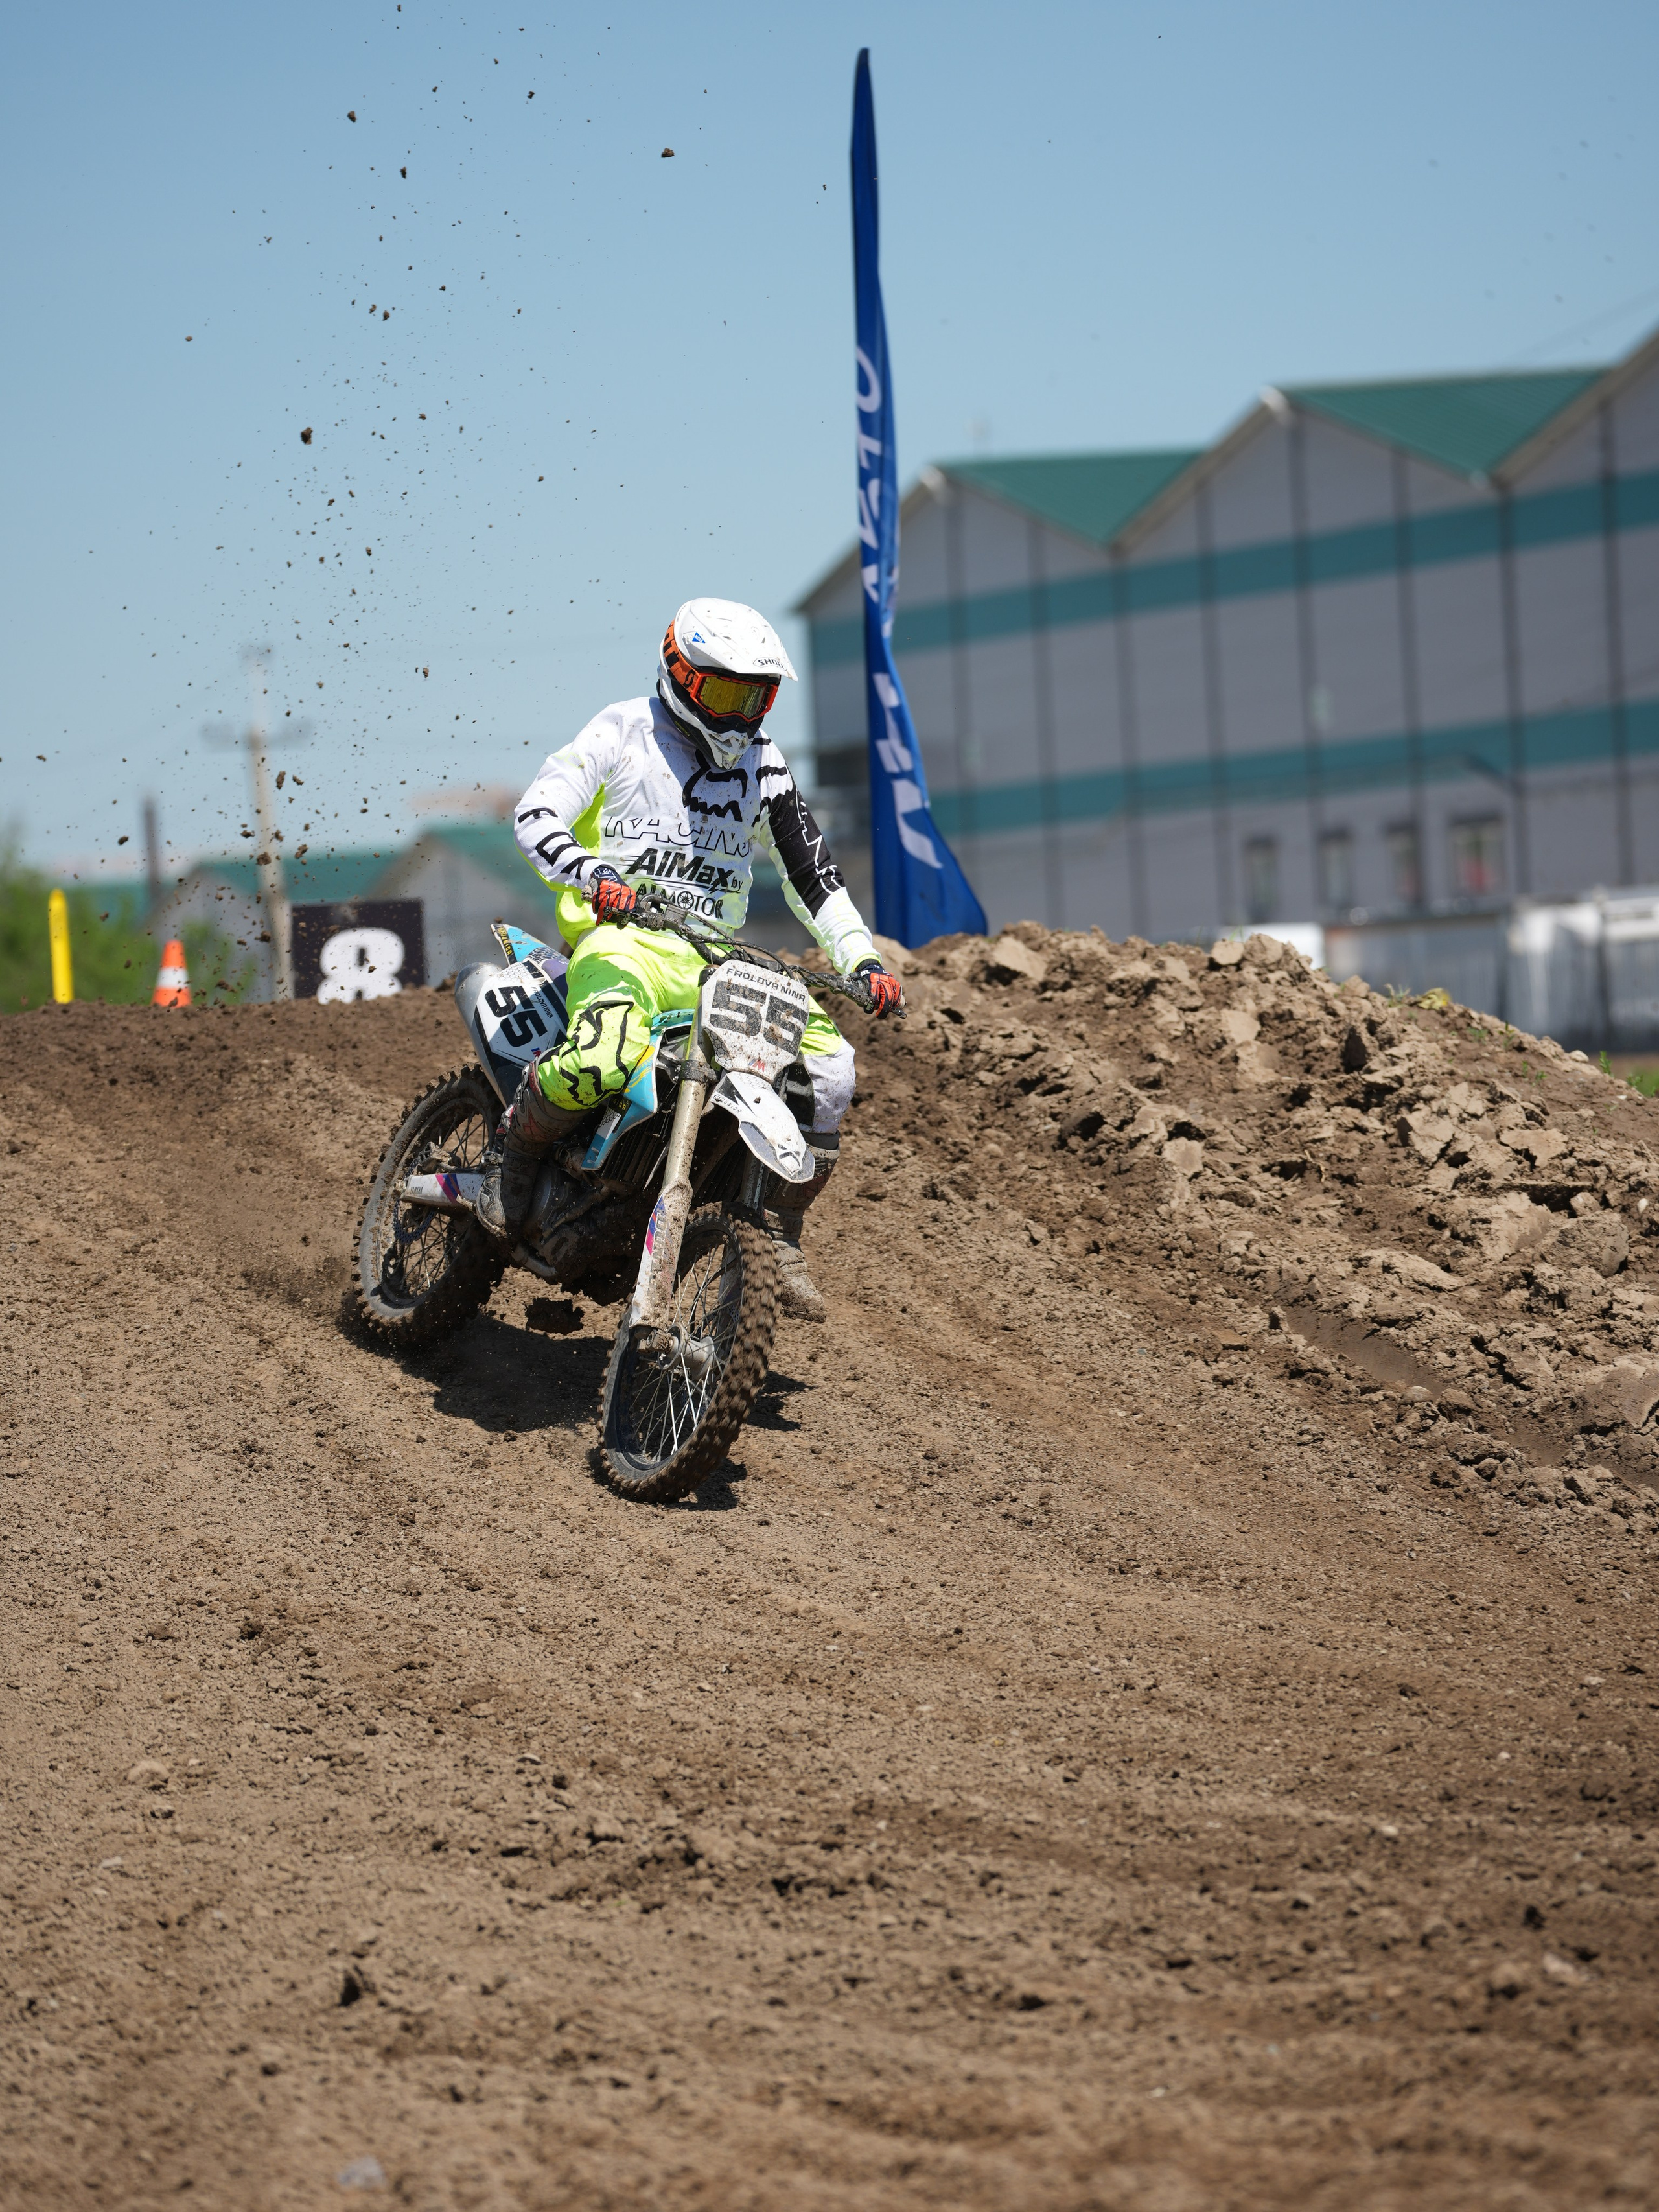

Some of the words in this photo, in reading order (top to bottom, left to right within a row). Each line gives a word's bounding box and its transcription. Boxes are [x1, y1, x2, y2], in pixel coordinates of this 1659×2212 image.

[730, 876, 743, 892] by
[316, 927, 405, 1005] 8
[726, 968, 778, 990] FROLOVA
[780, 986, 806, 1002] NINA
[485, 985, 548, 1047] 55
[531, 986, 547, 1008] FROLOVA
[544, 1006, 553, 1018] NINA
[710, 979, 809, 1057] 55
